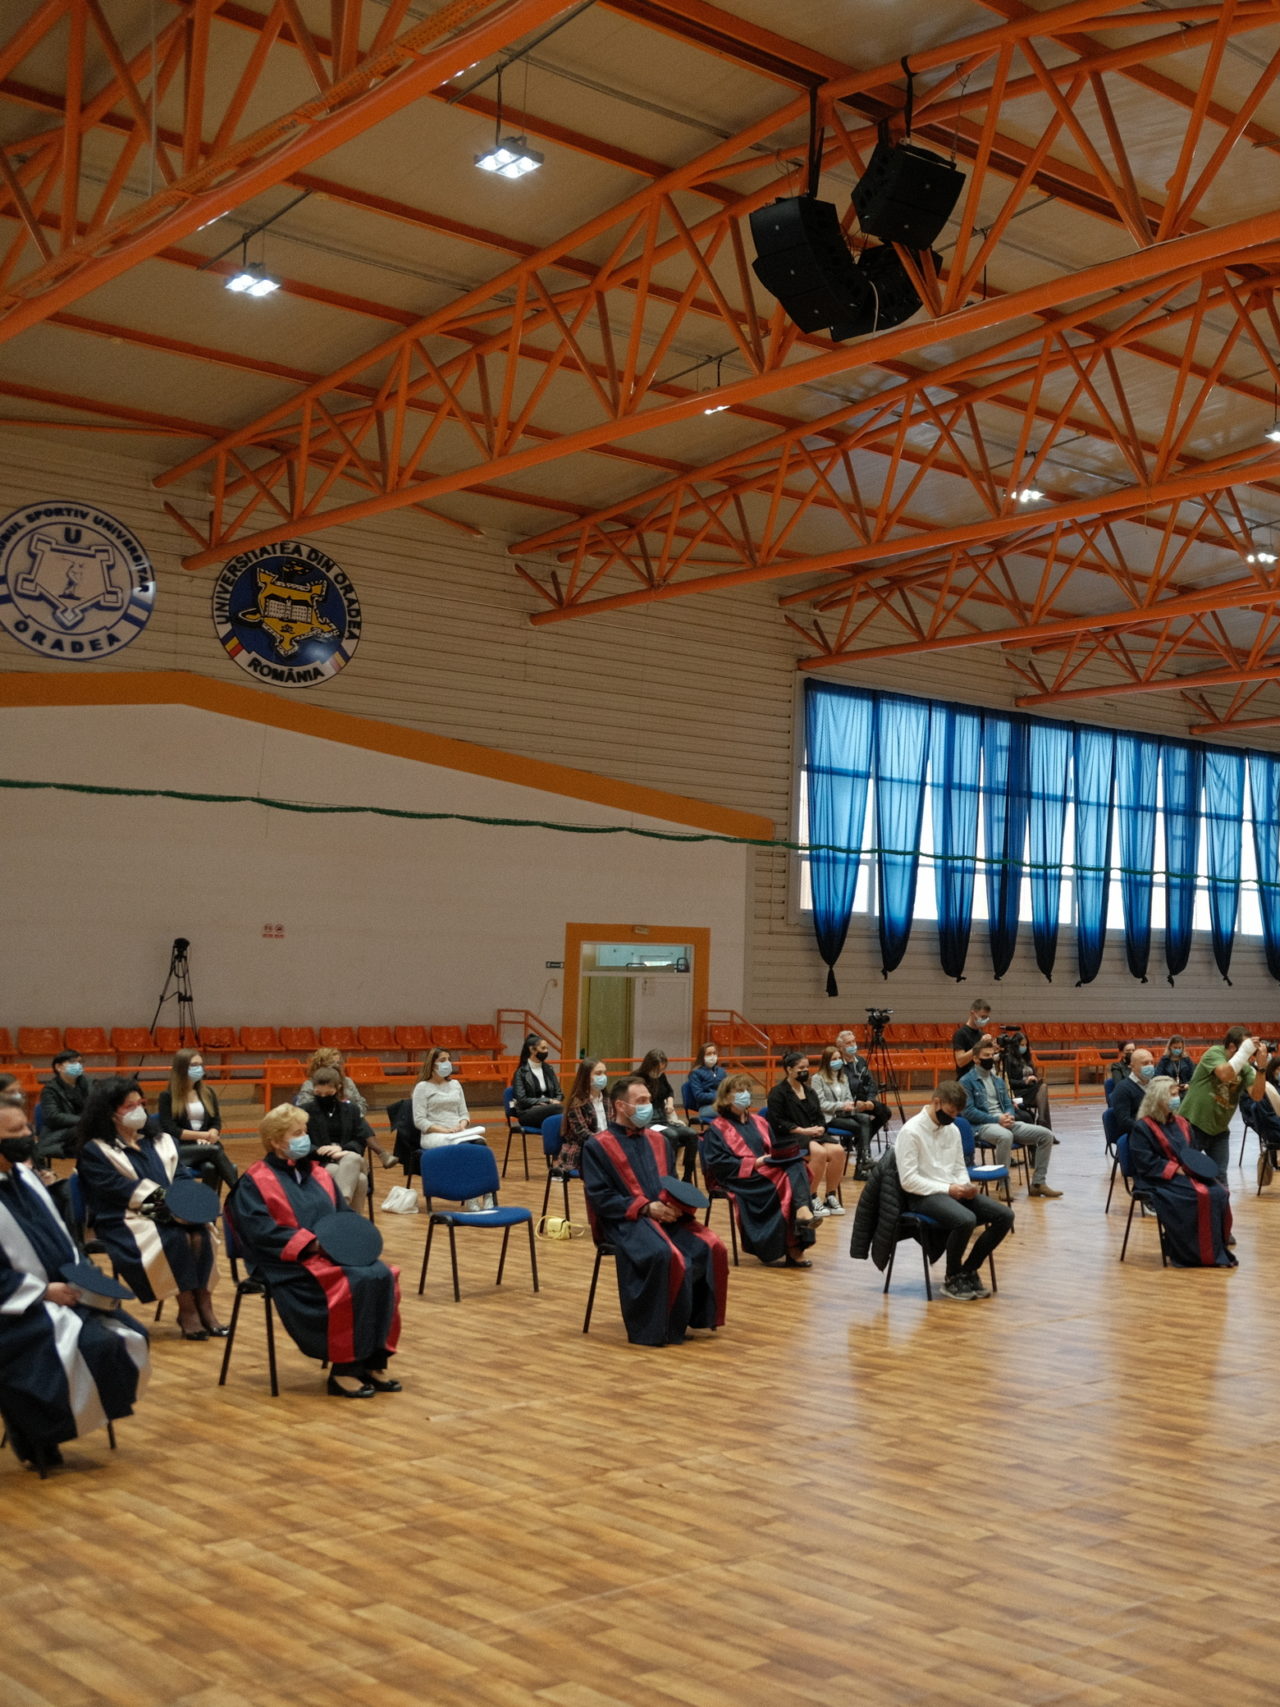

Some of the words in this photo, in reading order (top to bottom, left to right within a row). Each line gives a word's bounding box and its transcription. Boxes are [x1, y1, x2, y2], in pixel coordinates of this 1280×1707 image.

[25, 507, 90, 524] SPORTIV
[93, 515, 150, 593] UNIVERSITAR
[64, 527, 82, 544] U
[214, 542, 303, 625] UNIVERSITATEA
[306, 548, 336, 574] DIN
[333, 573, 361, 641] ORADEA
[14, 620, 122, 653] ORADEA
[247, 657, 326, 683] ROMÂNIA
